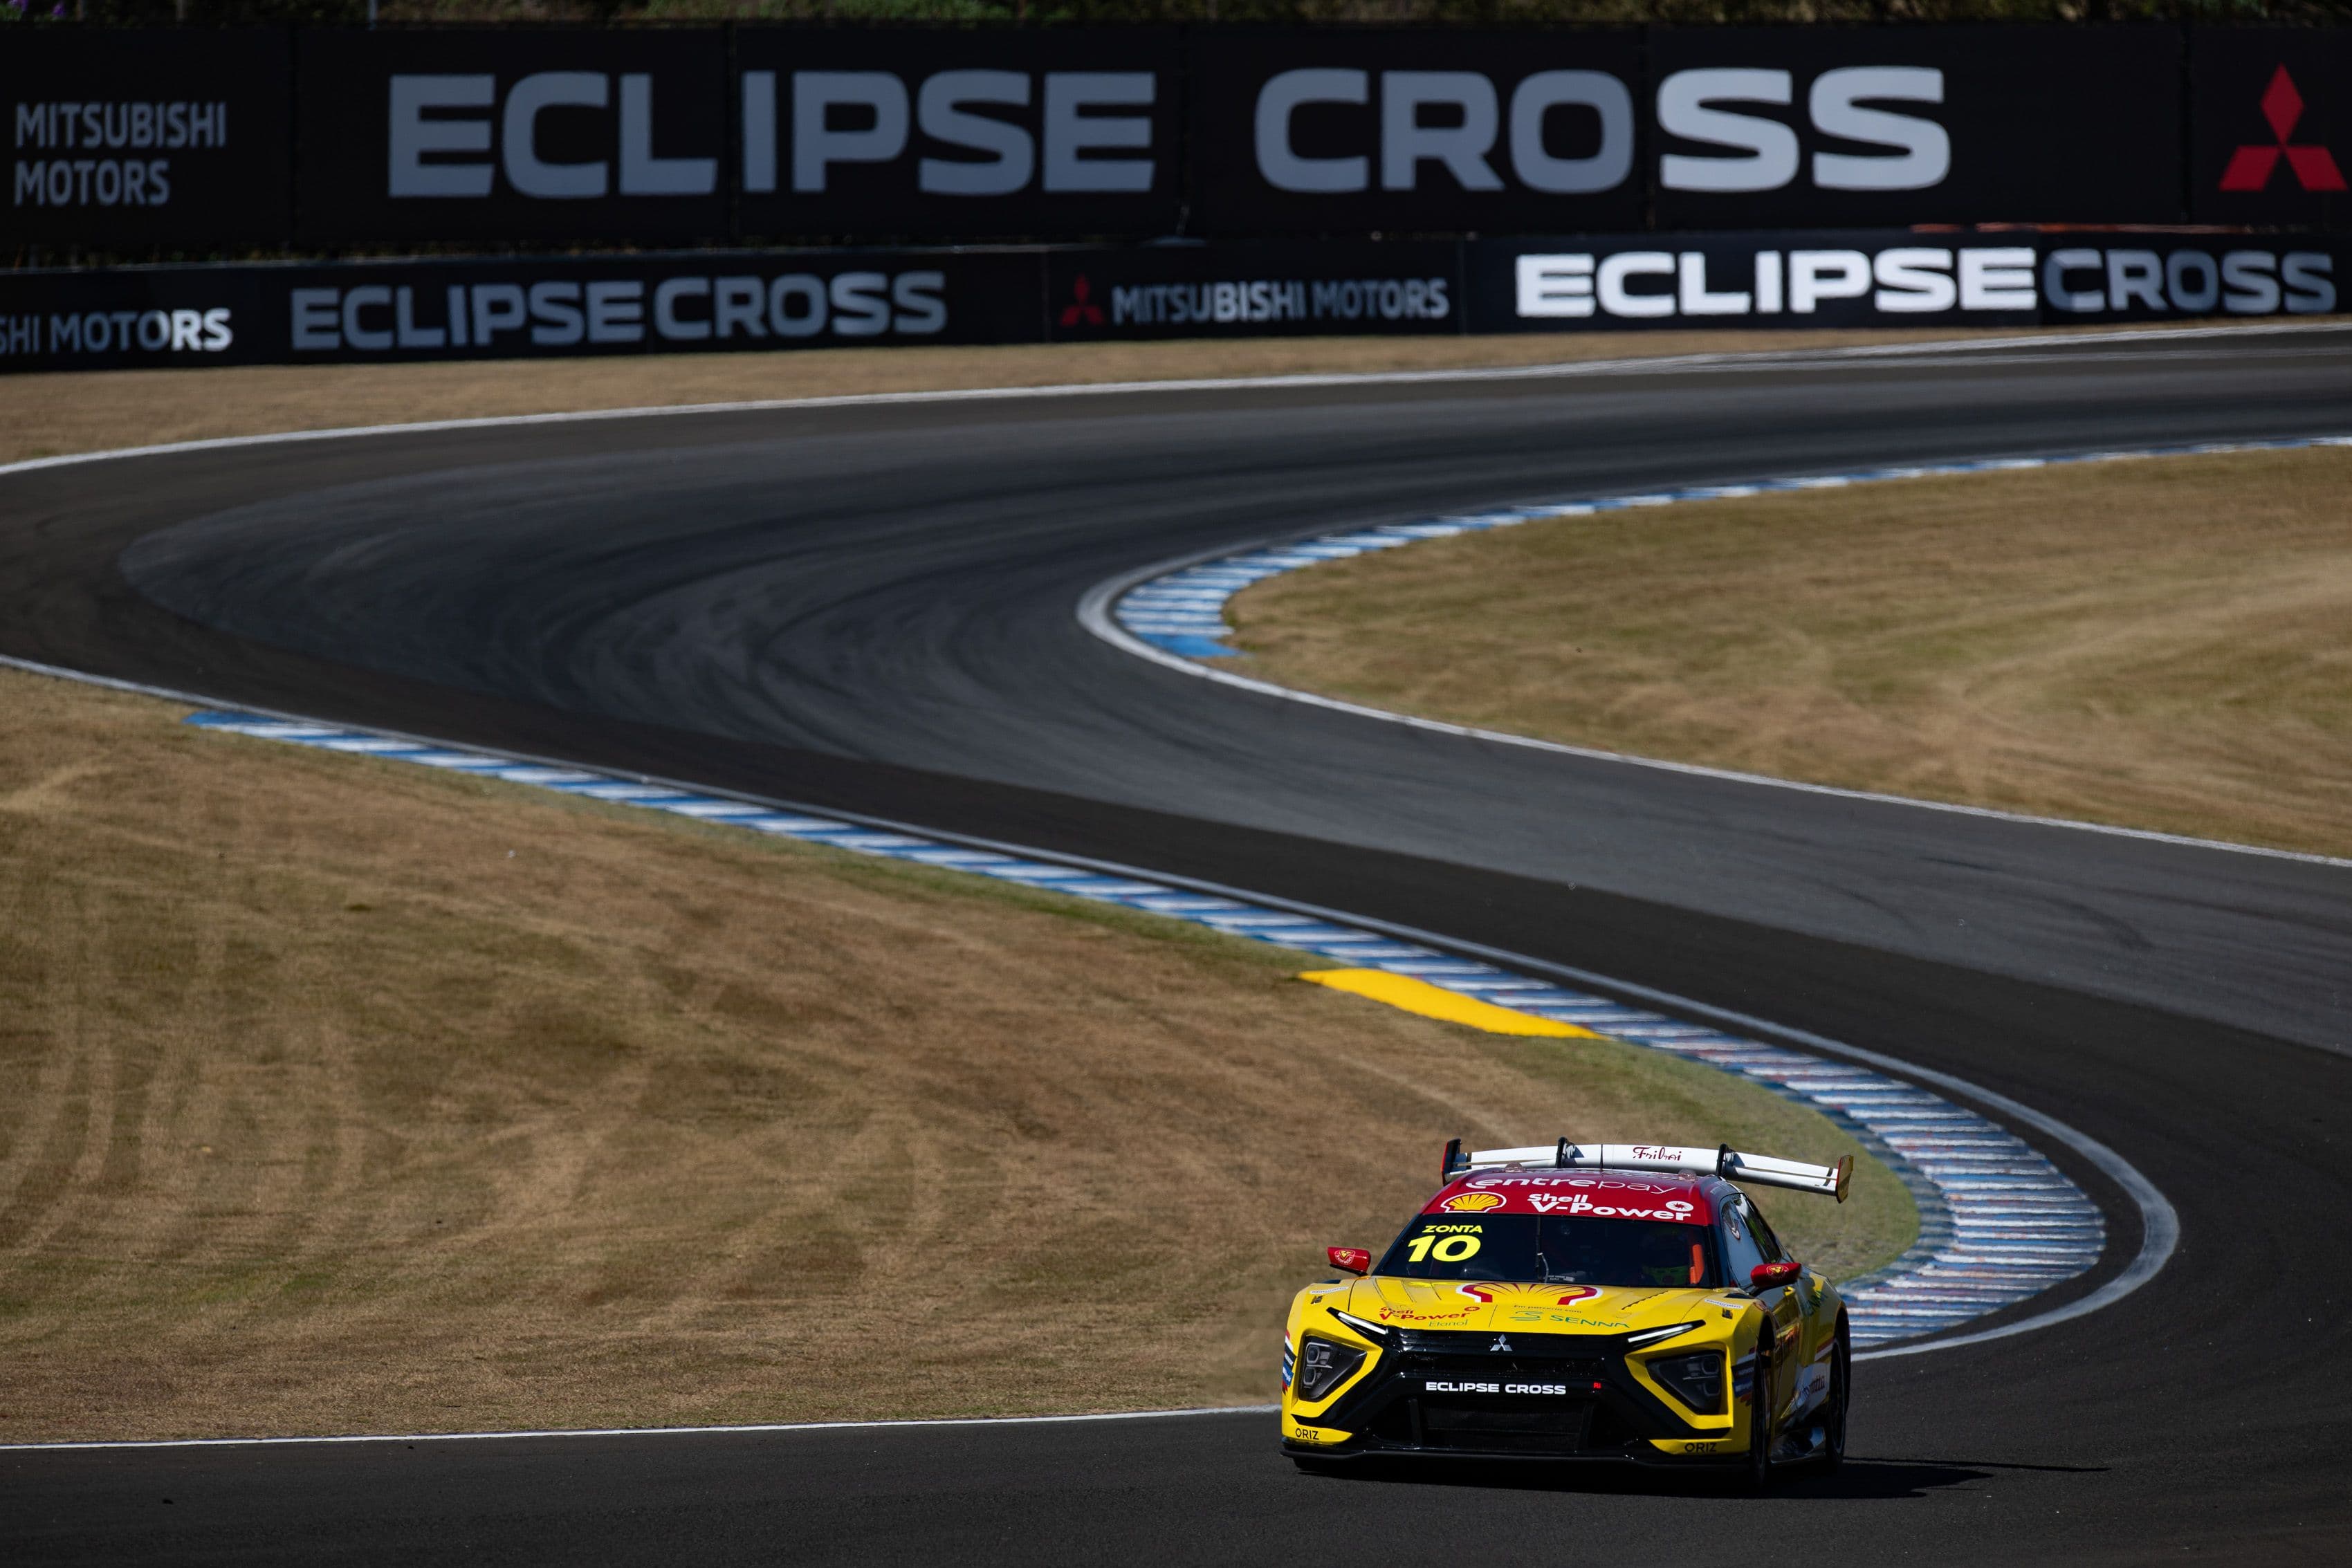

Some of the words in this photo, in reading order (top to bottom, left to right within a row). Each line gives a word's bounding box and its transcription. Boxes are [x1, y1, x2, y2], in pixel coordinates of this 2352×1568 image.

[15, 101, 227, 149] MITSUBISHI
[389, 69, 1156, 199] ECLIPSE
[1255, 66, 1951, 194] CROSS
[14, 159, 170, 207] MOTORS
[1515, 247, 2037, 318] ECLIPSE
[2043, 248, 2337, 315] CROSS
[291, 279, 644, 351] ECLIPSE
[654, 271, 948, 340] CROSS
[1112, 280, 1307, 325] MITSUBISHI
[1314, 278, 1450, 322] MOTORS
[48, 307, 234, 353] MOTORS
[1633, 1146, 1682, 1161] Friboi
[1466, 1177, 1677, 1195] entrepay
[1527, 1192, 1588, 1203] Shell
[1531, 1201, 1691, 1221] V-Power
[1422, 1225, 1483, 1233] ZONTA
[1408, 1235, 1481, 1262] 10
[1550, 1315, 1630, 1329] SENNA
[1426, 1381, 1500, 1393] ECLIPSE
[1505, 1384, 1566, 1395] CROSS
[1295, 1428, 1319, 1440] ORIZ
[1684, 1443, 1717, 1452] ORIZ
